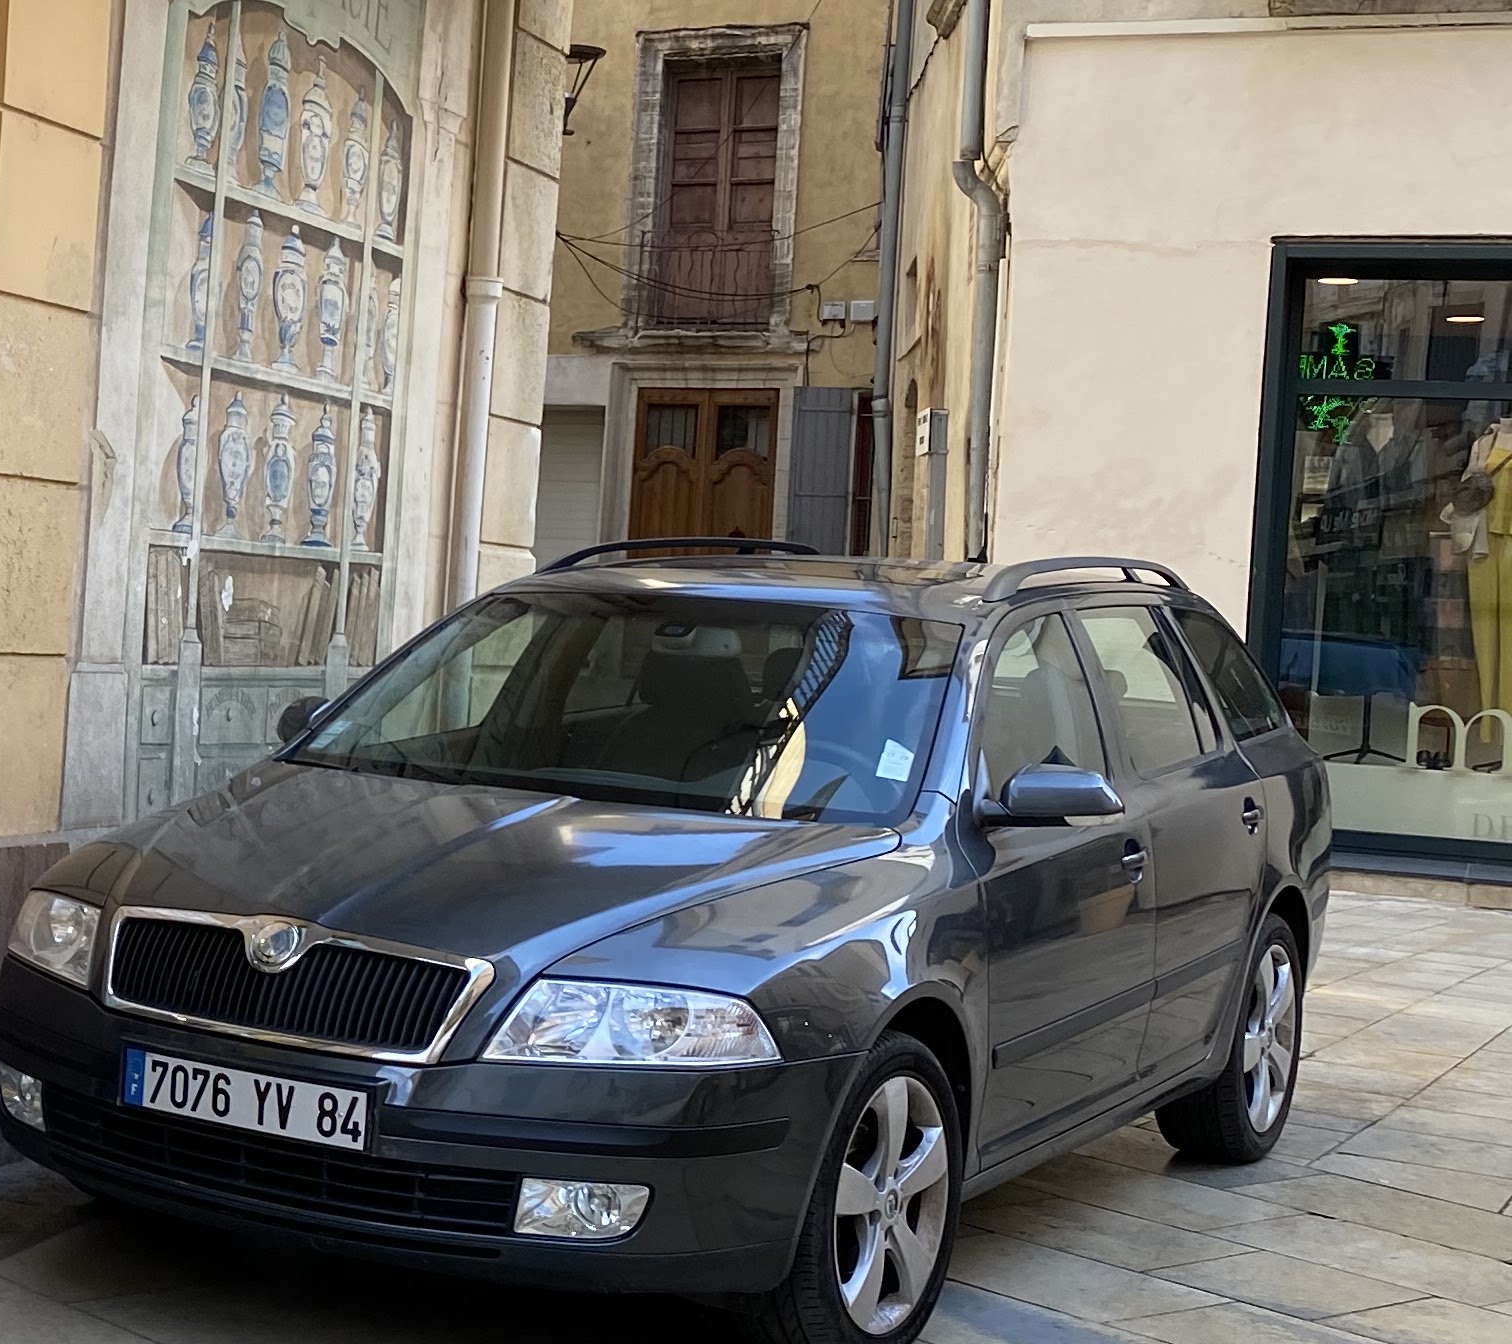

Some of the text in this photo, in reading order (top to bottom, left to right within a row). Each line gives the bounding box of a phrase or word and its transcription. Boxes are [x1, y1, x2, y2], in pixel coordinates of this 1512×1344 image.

[149, 1059, 232, 1117] 7076
[253, 1079, 295, 1130] YV
[316, 1091, 362, 1143] 84
